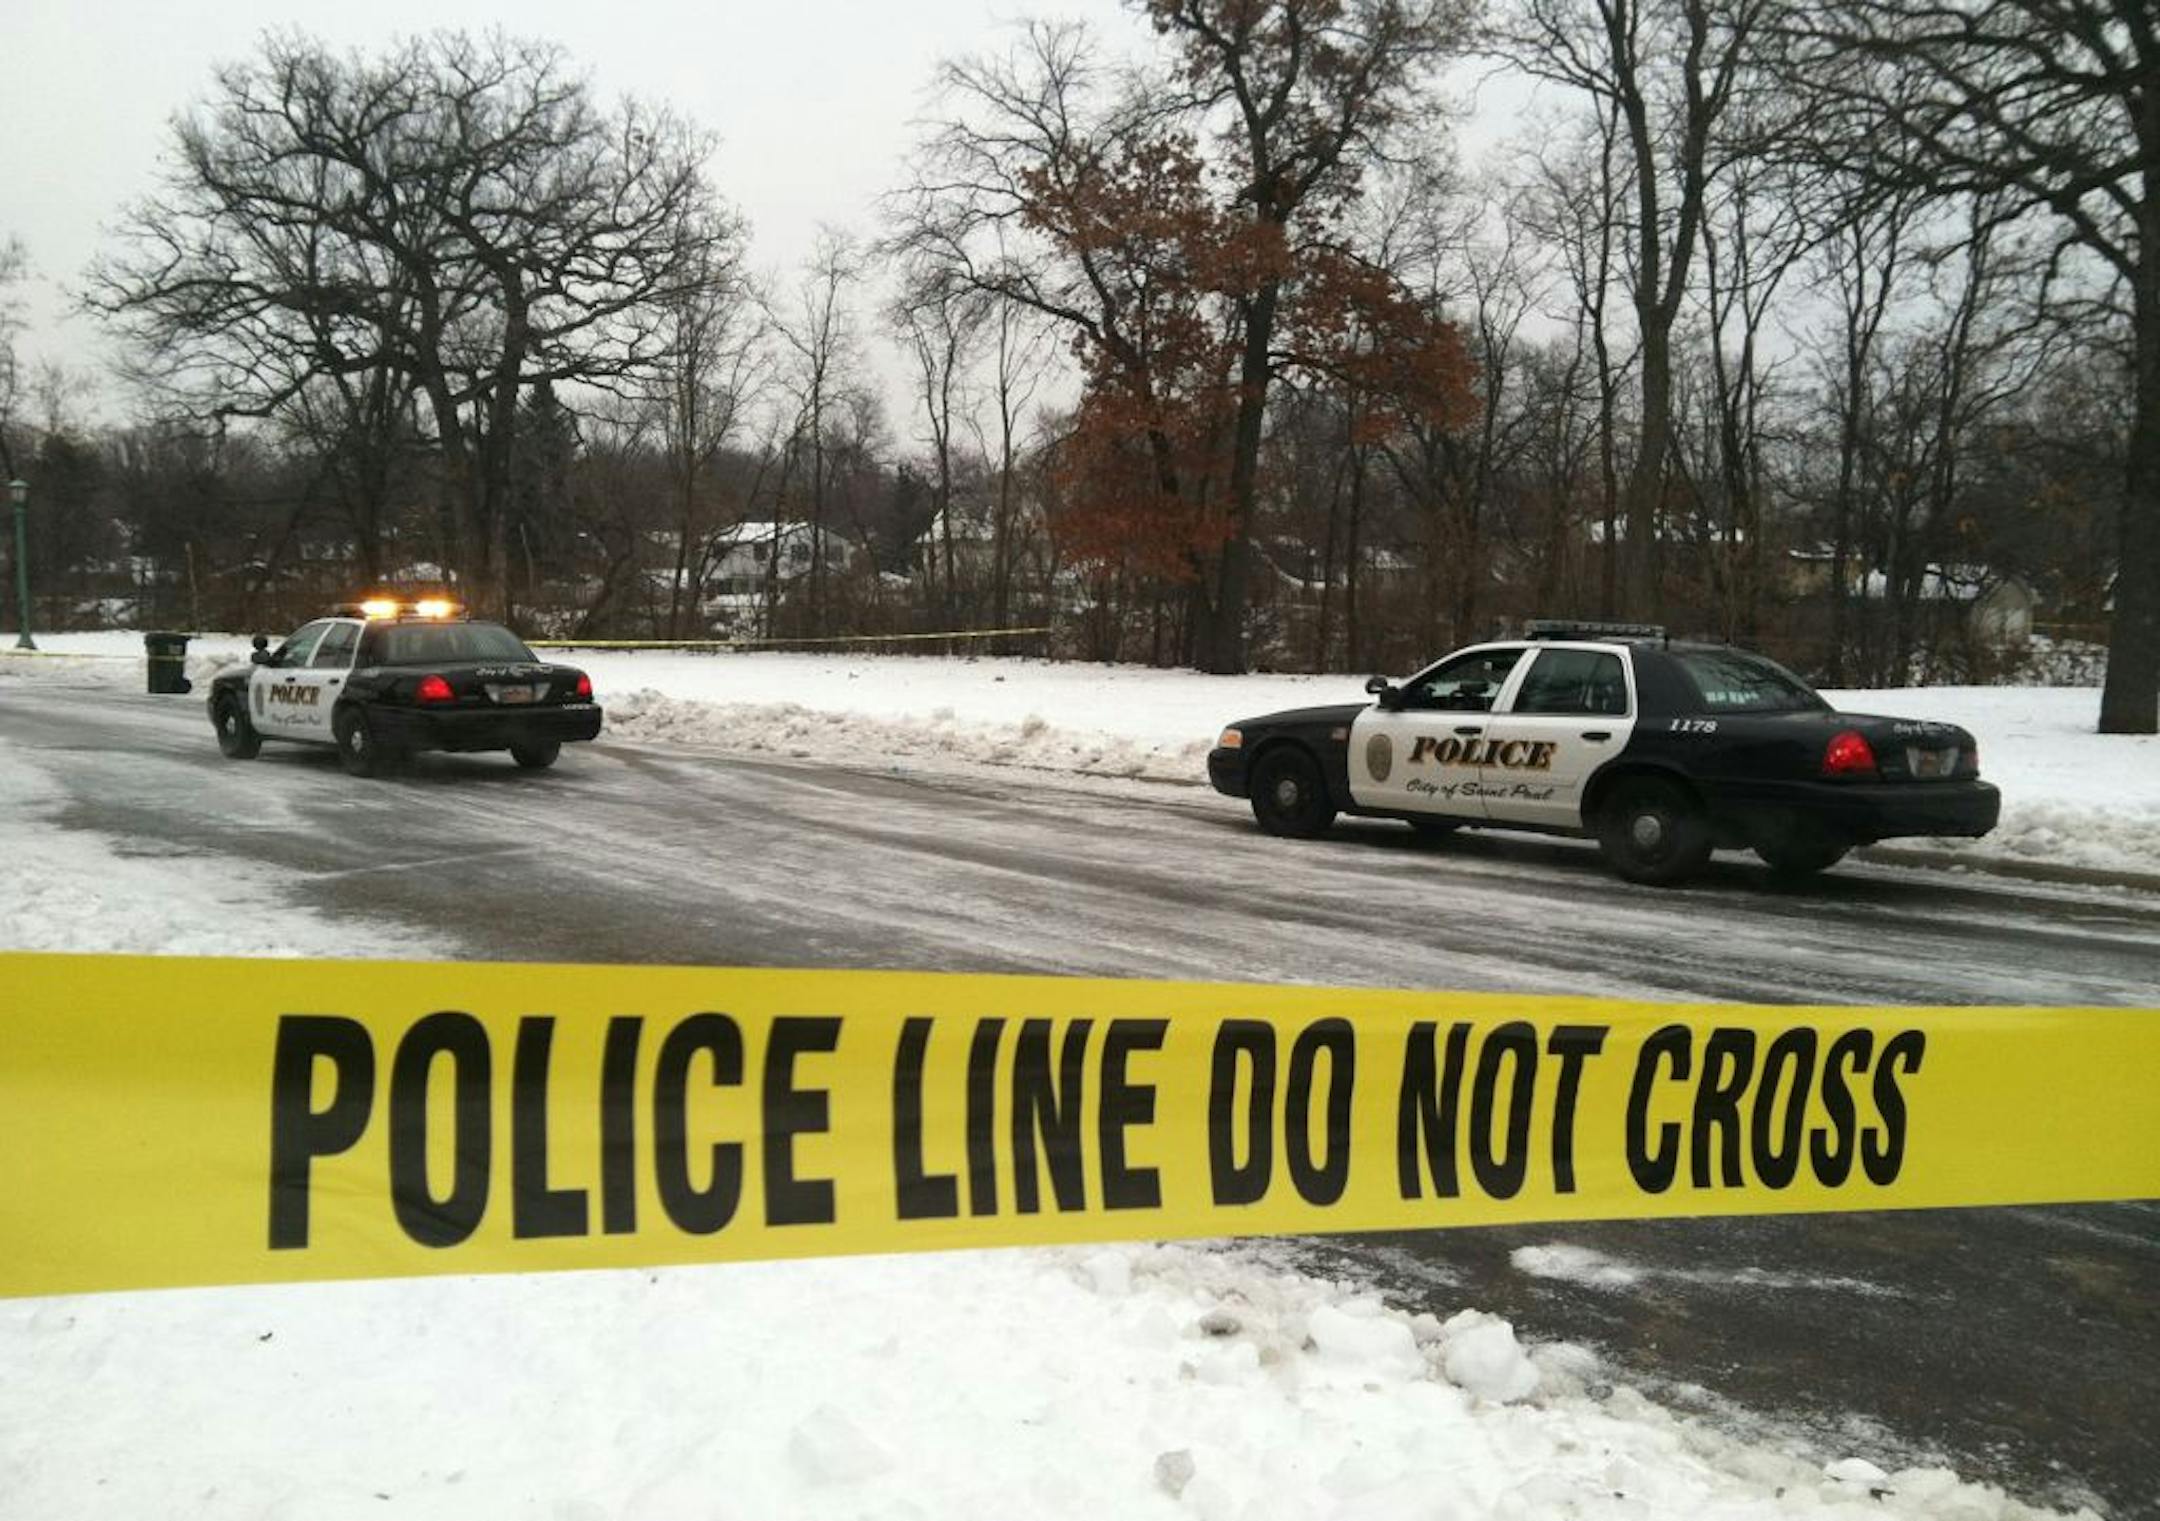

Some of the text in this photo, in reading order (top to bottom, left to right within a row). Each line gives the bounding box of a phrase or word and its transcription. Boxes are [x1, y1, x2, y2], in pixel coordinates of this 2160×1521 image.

[269, 683, 320, 706] POLICE
[1669, 718, 1718, 733] 1178
[1407, 736, 1557, 770] POLICE
[268, 1011, 1925, 1251] POLICE LINE DO NOT CROSS
